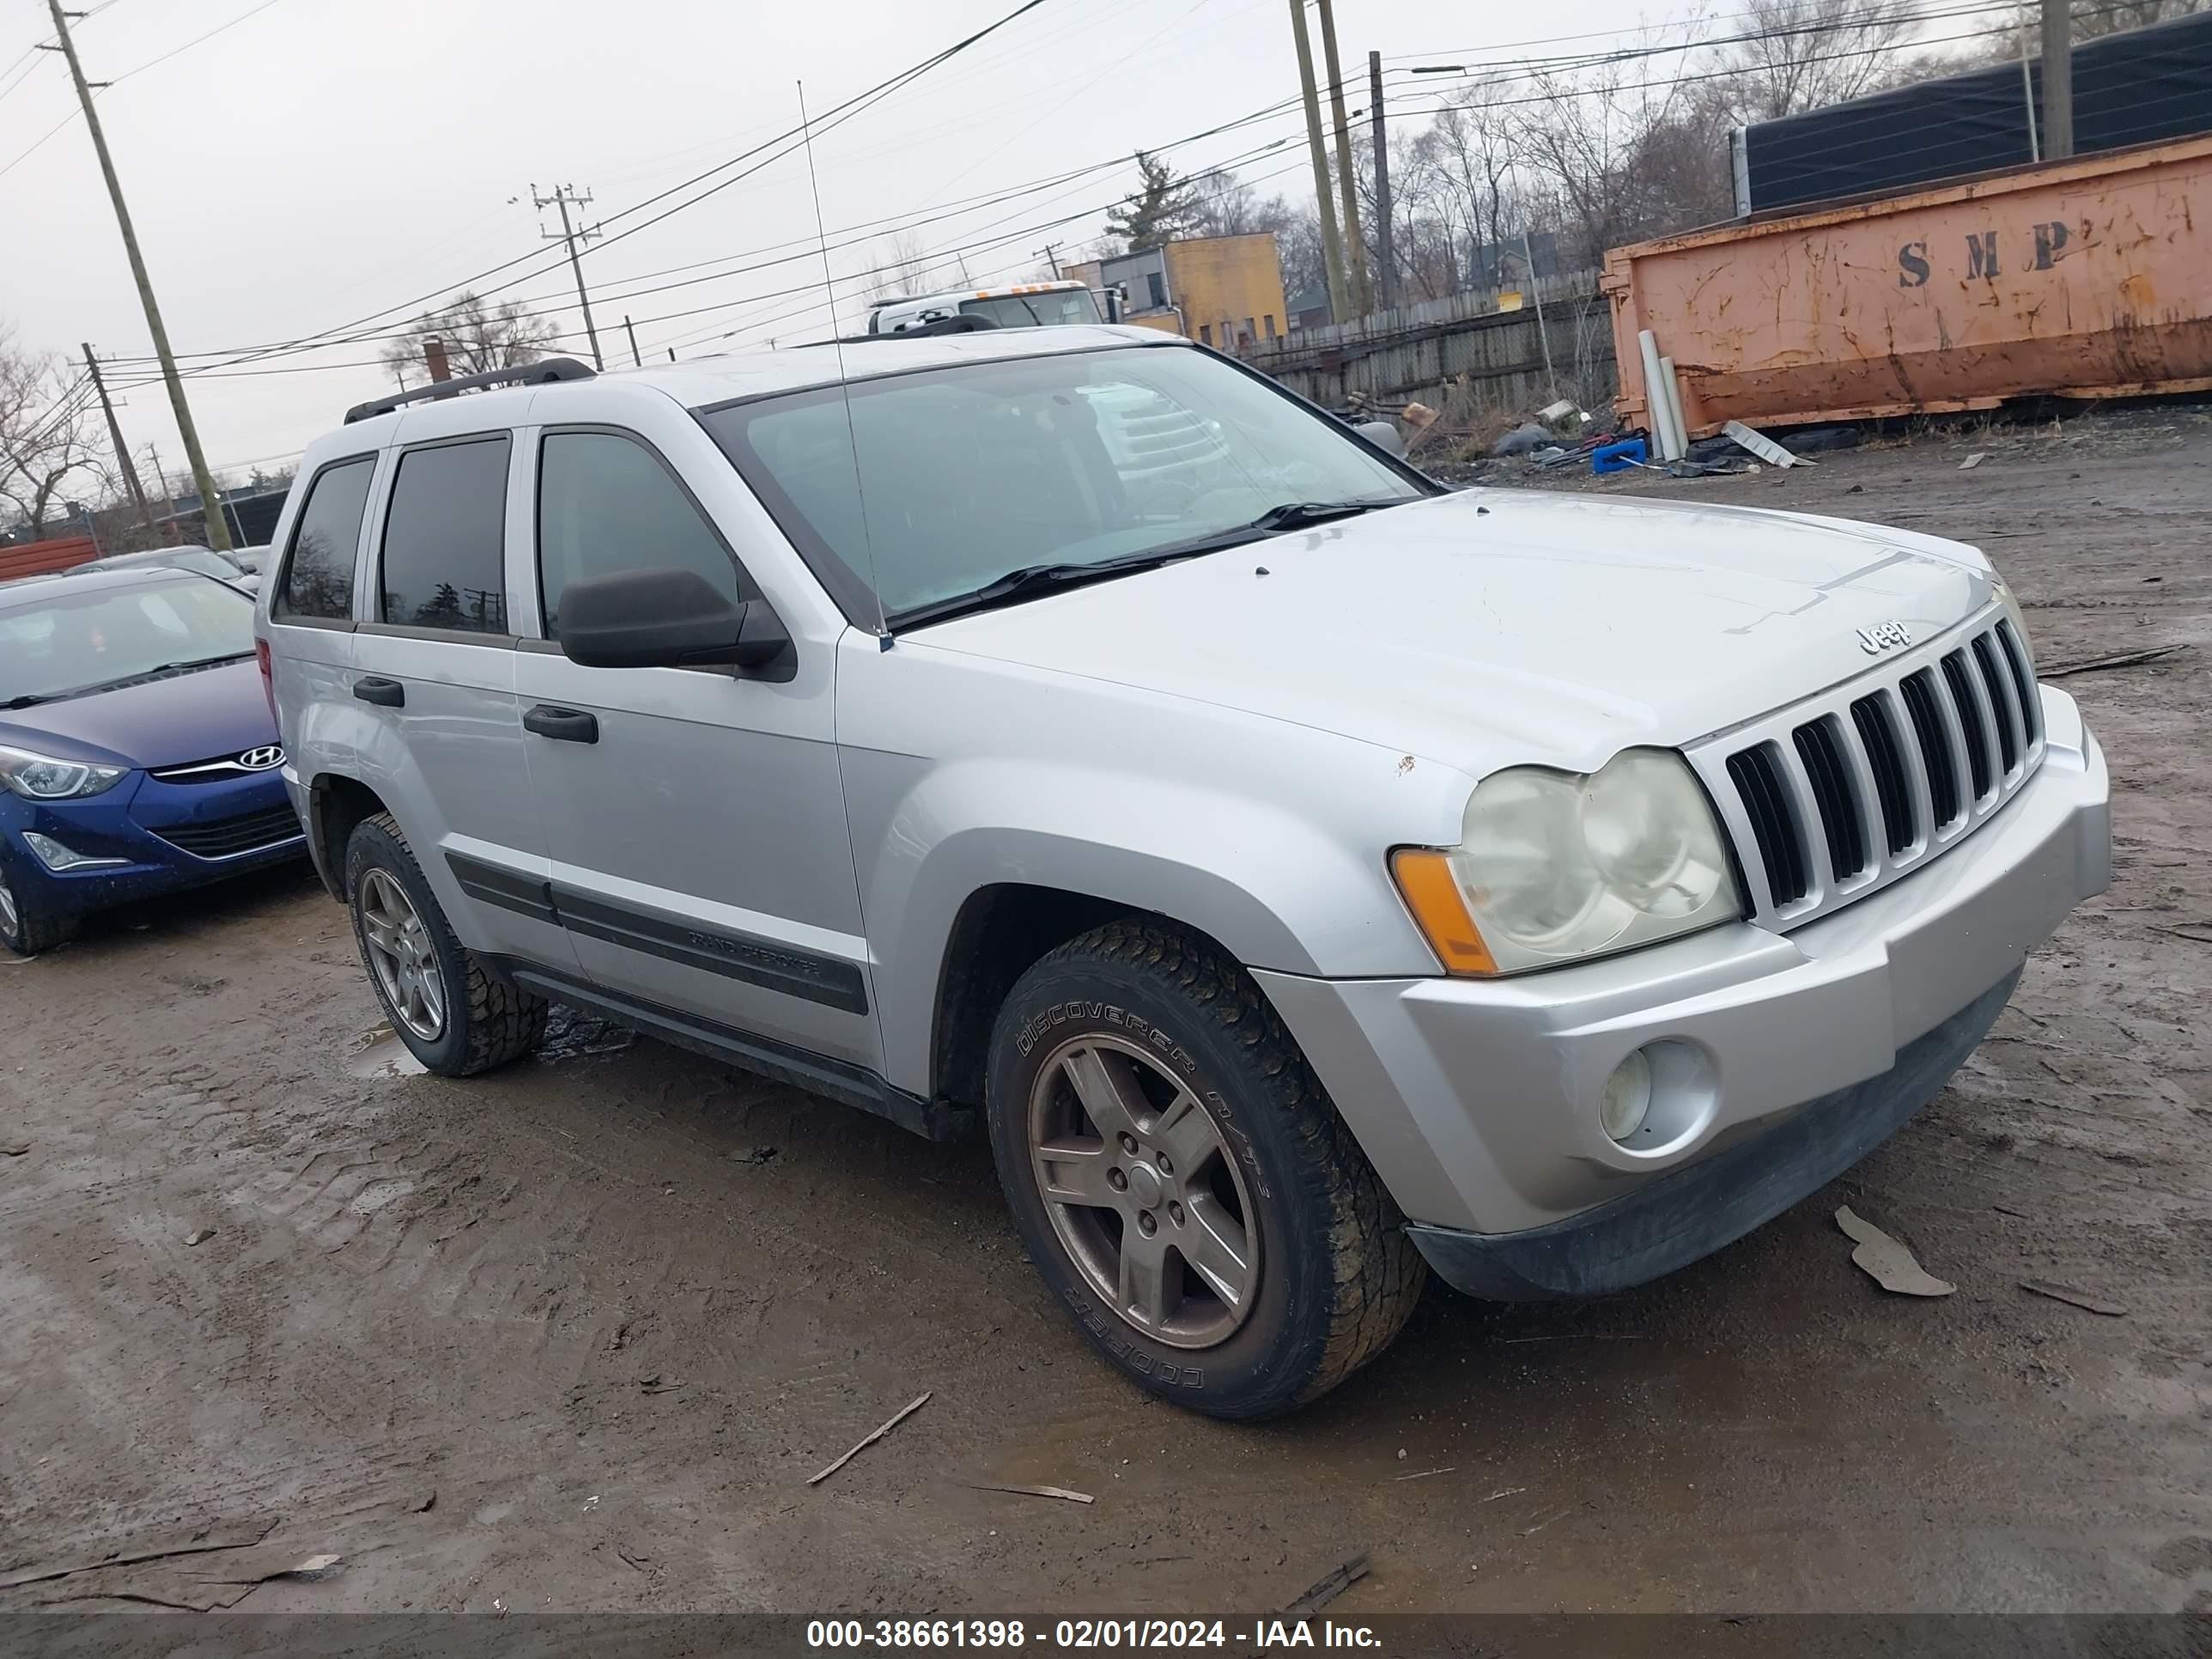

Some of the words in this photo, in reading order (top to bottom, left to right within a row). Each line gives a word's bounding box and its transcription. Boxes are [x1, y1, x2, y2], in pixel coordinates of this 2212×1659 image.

[1855, 619, 1911, 654] Jeep
[688, 931, 737, 954] GRAND
[741, 945, 821, 975] CHEROKEE
[1016, 1000, 1198, 1075] DISCOVERER
[1066, 1285, 1205, 1389] COOPER
